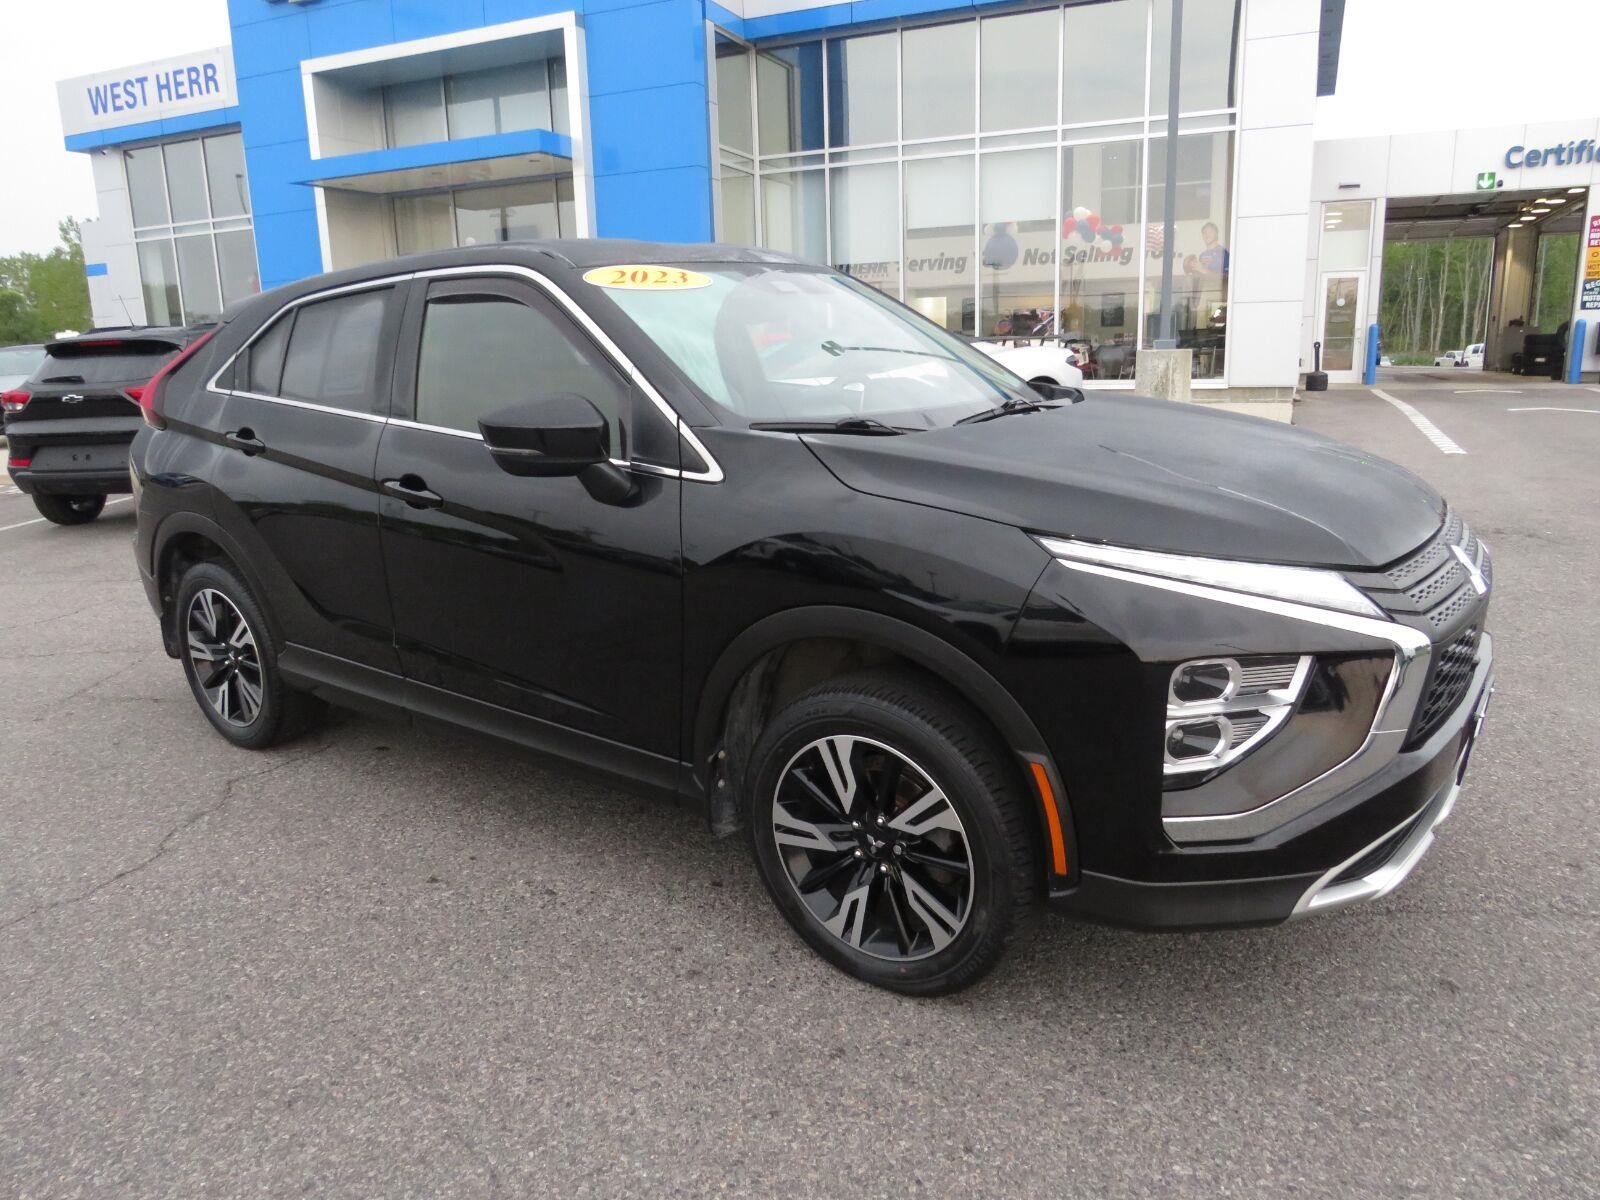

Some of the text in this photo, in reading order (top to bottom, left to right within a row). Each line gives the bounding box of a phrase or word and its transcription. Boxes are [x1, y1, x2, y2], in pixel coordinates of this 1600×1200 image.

[87, 63, 219, 115] WEST HERR
[897, 252, 967, 274] erving
[610, 270, 688, 284] 2023
